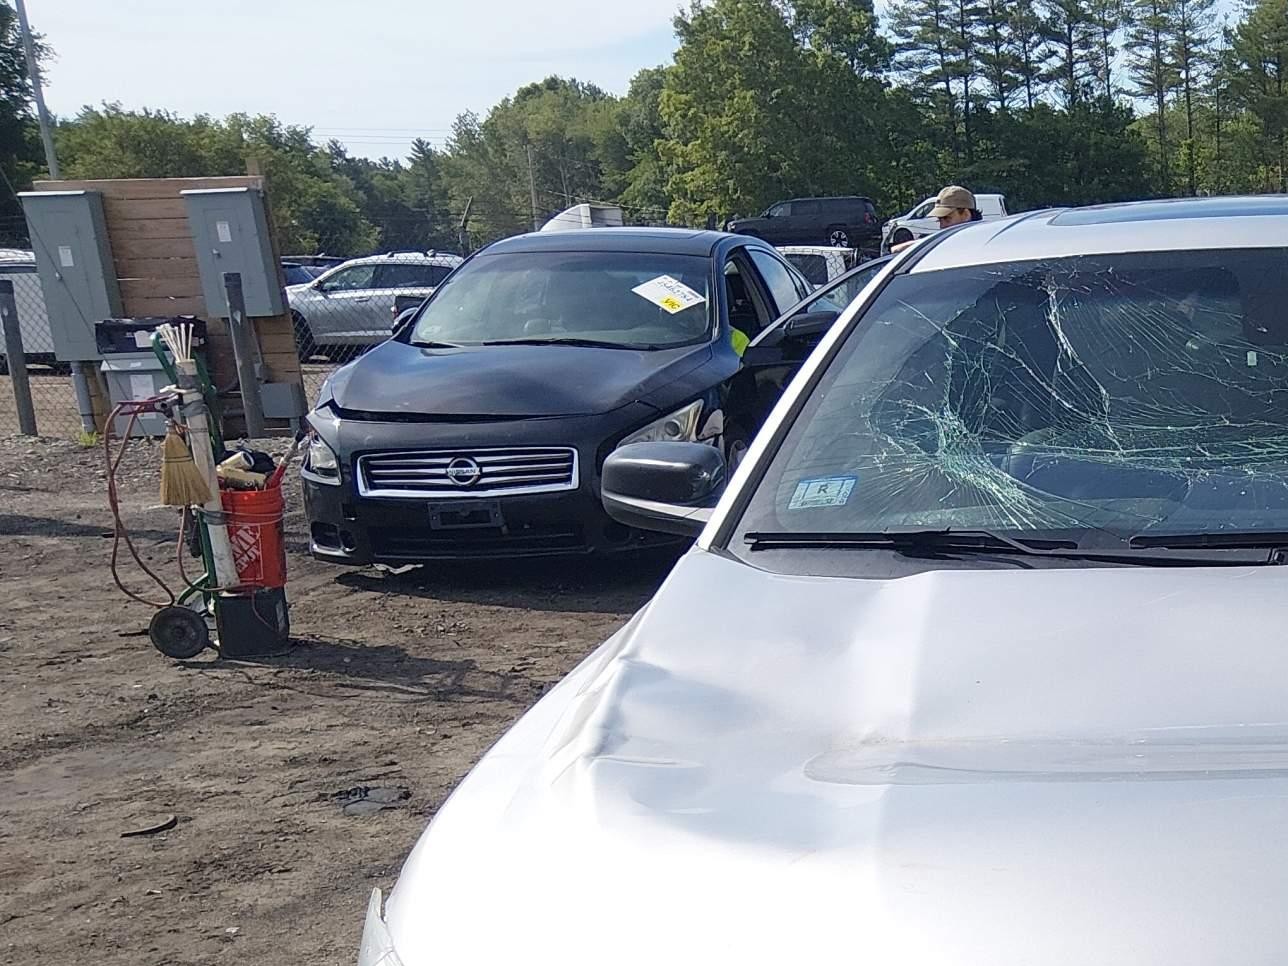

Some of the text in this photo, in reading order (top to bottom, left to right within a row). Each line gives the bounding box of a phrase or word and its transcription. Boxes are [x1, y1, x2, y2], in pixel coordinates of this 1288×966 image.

[664, 298, 680, 309] VIC
[448, 468, 477, 476] NISSAN
[817, 485, 829, 494] R
